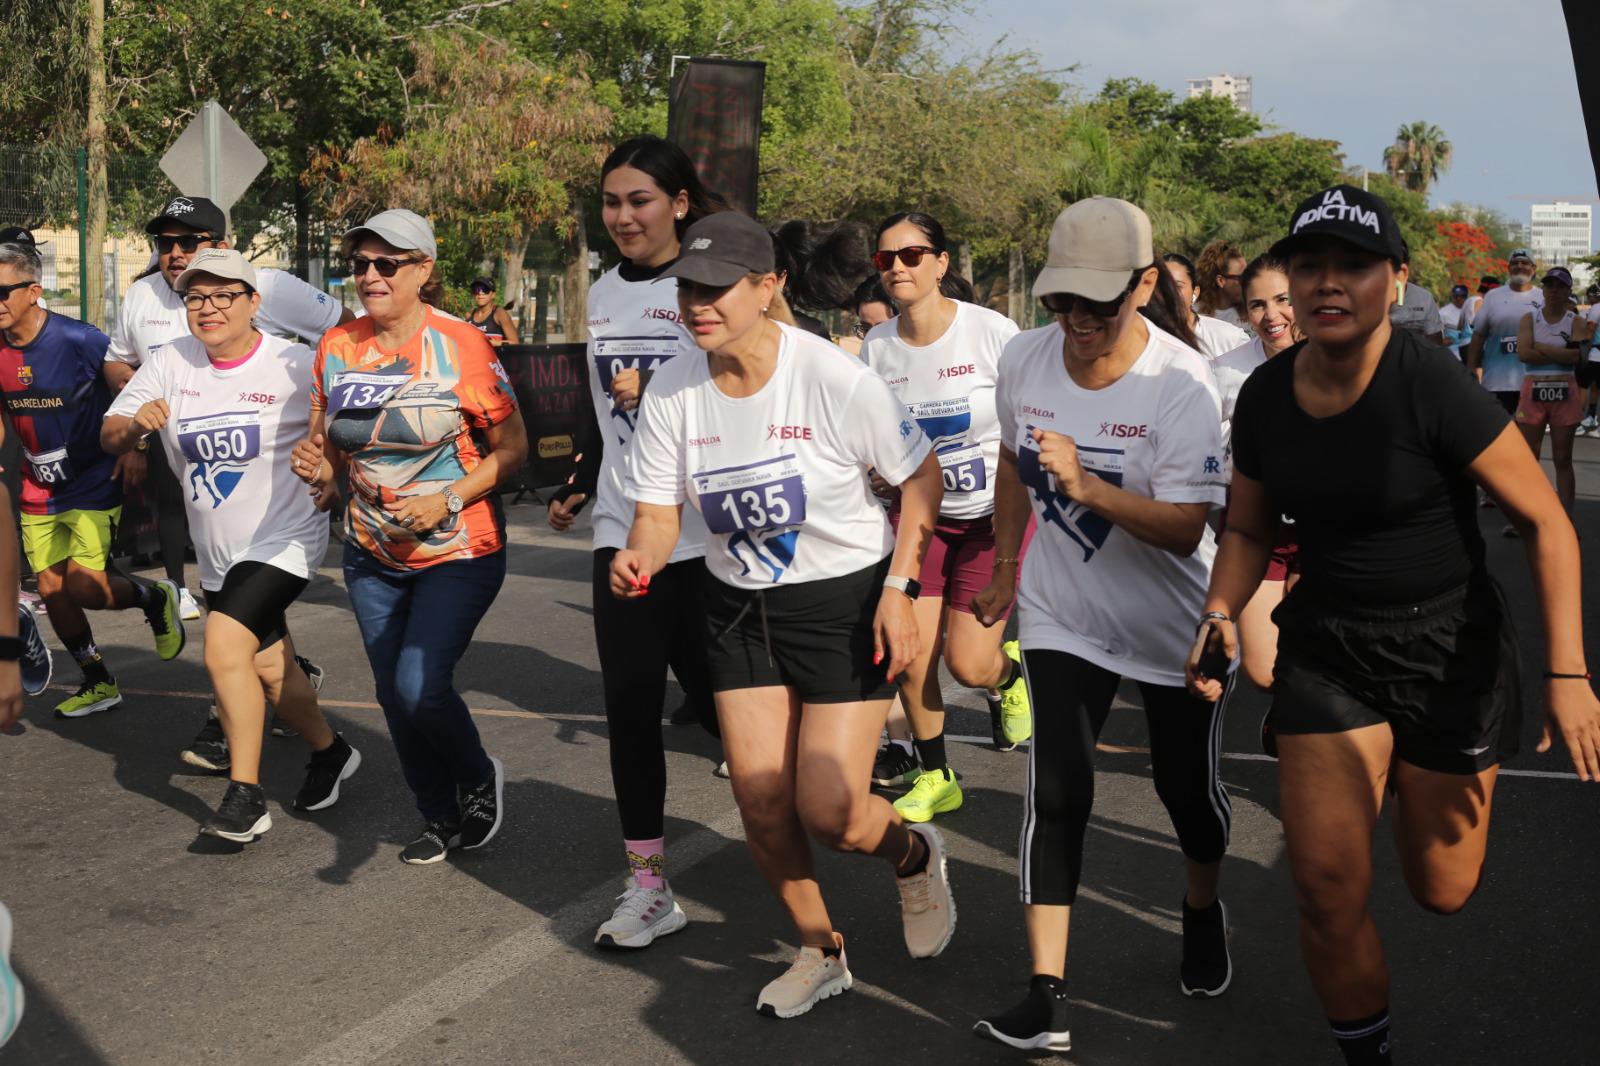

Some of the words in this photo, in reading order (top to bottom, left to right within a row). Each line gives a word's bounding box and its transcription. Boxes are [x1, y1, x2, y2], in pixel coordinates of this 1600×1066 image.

[1322, 189, 1346, 205] LA
[1292, 204, 1380, 234] ADICTIVA
[947, 364, 976, 378] ISDE
[247, 393, 276, 404] ISDE
[341, 384, 394, 408] 134
[1539, 388, 1564, 401] 004
[13, 397, 64, 409] BARCELONA
[780, 426, 812, 440] ISDE
[1110, 424, 1148, 438] ISDE
[195, 428, 247, 461] 050
[943, 463, 976, 491] 05
[721, 484, 791, 529] 135
